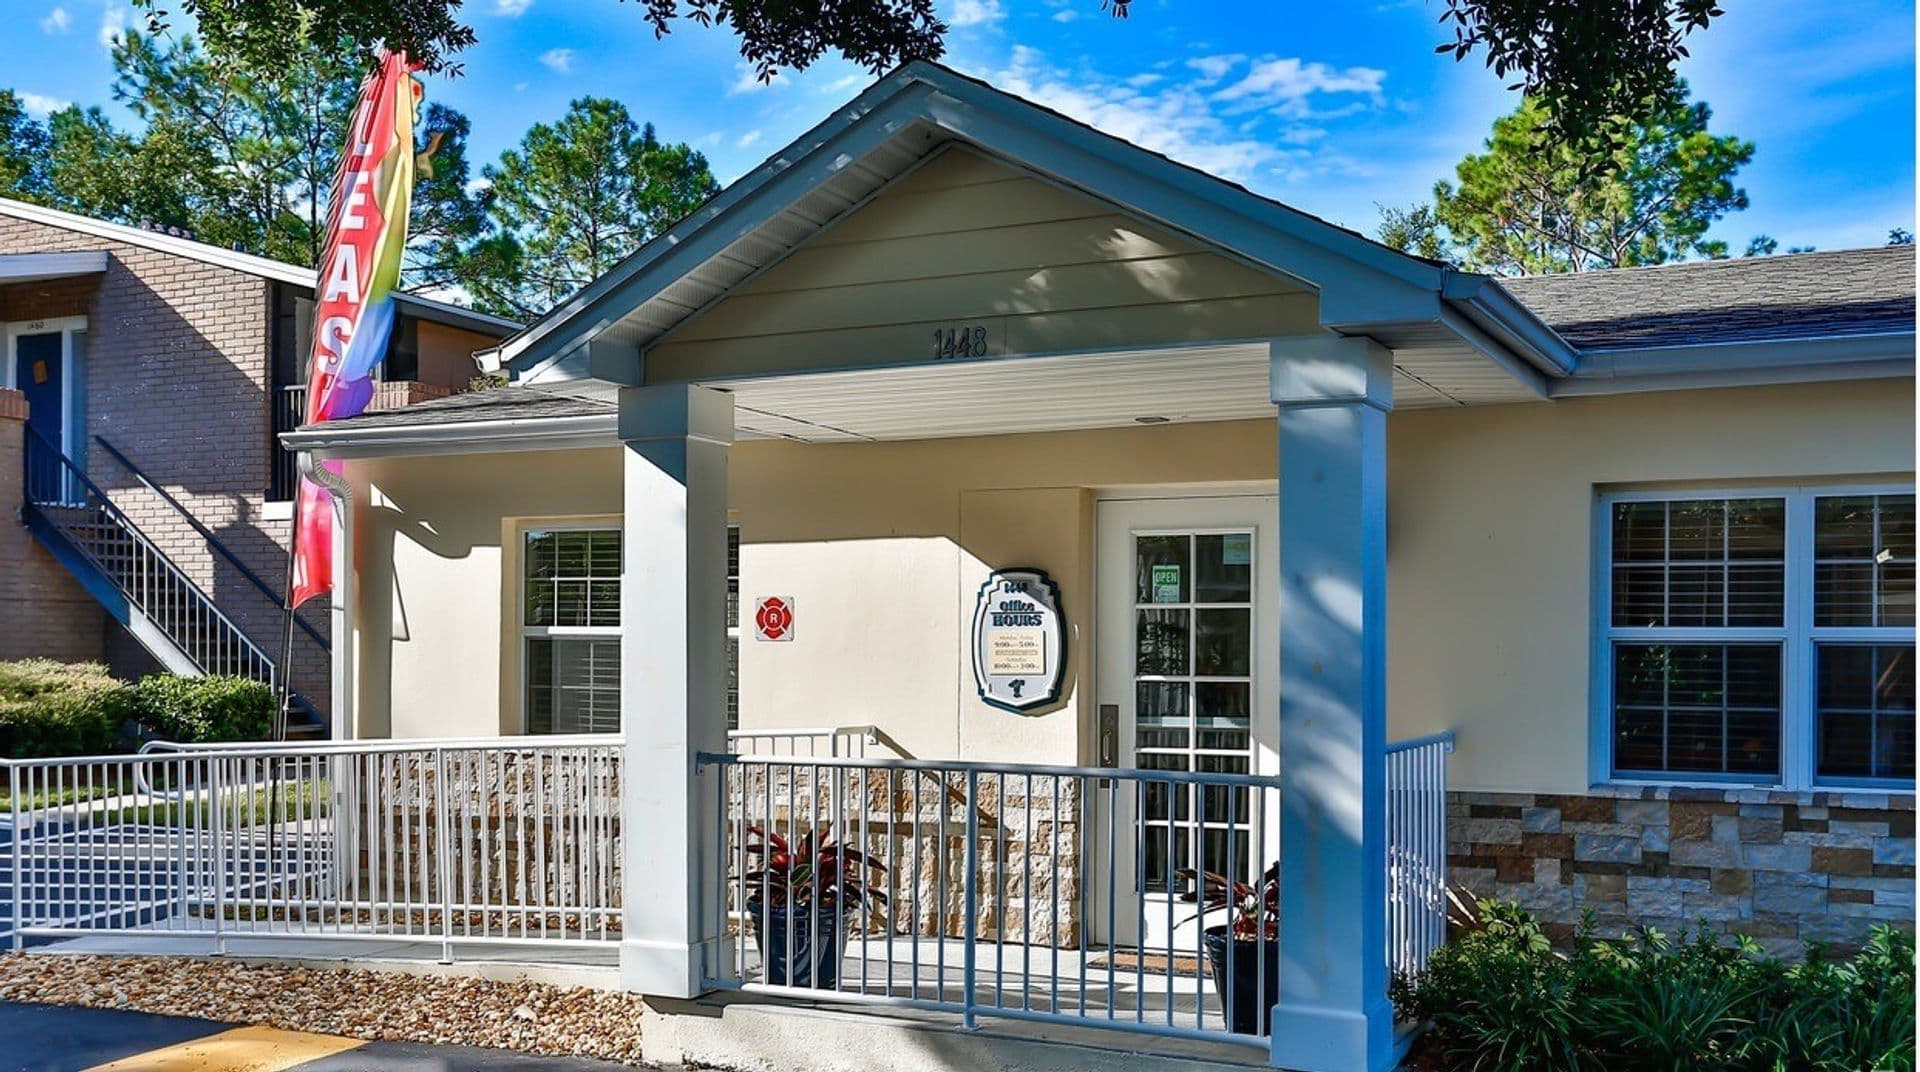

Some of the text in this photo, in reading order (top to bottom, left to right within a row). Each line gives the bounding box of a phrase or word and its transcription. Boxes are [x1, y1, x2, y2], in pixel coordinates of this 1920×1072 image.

[317, 99, 373, 400] LEAS
[934, 326, 987, 359] 1448
[1155, 571, 1177, 583] OPEN
[999, 599, 1036, 612] Office
[770, 613, 778, 623] R
[993, 614, 1042, 627] HOURS
